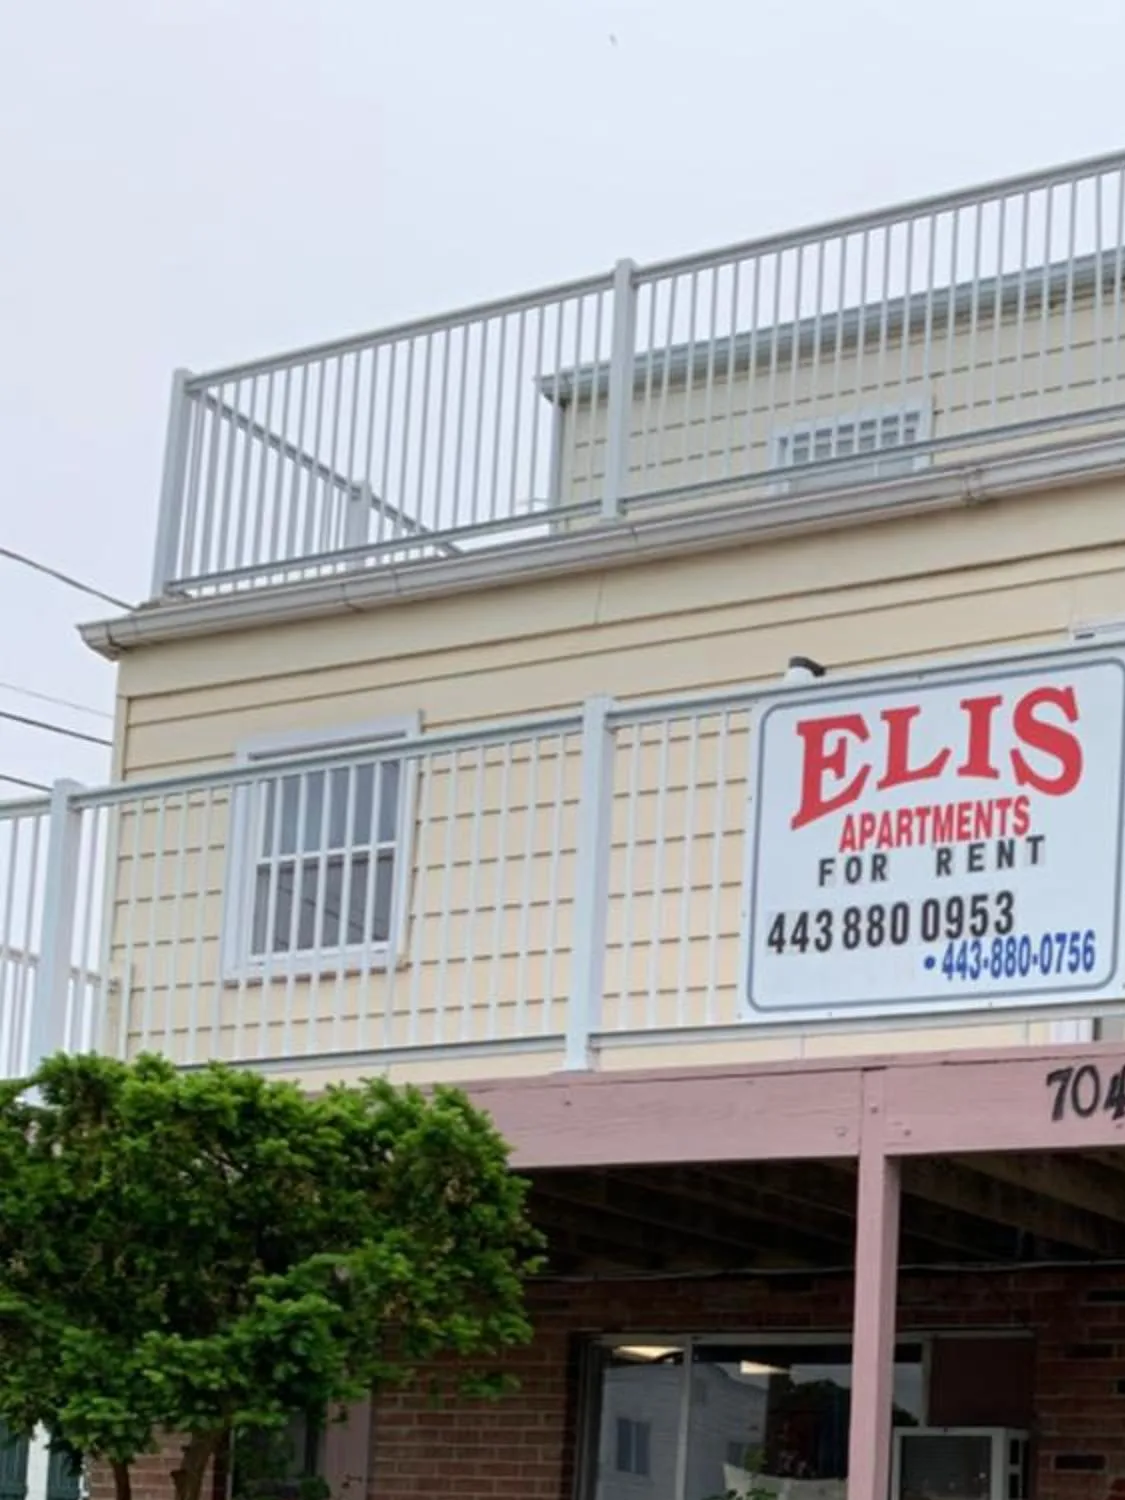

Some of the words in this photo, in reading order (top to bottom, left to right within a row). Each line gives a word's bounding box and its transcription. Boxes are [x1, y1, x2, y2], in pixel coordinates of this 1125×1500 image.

[790, 686, 1084, 830] ELIS
[839, 795, 1031, 853] APARTMENTS
[818, 854, 888, 886] FOR
[935, 835, 1045, 876] RENT
[920, 890, 1015, 942] 0953
